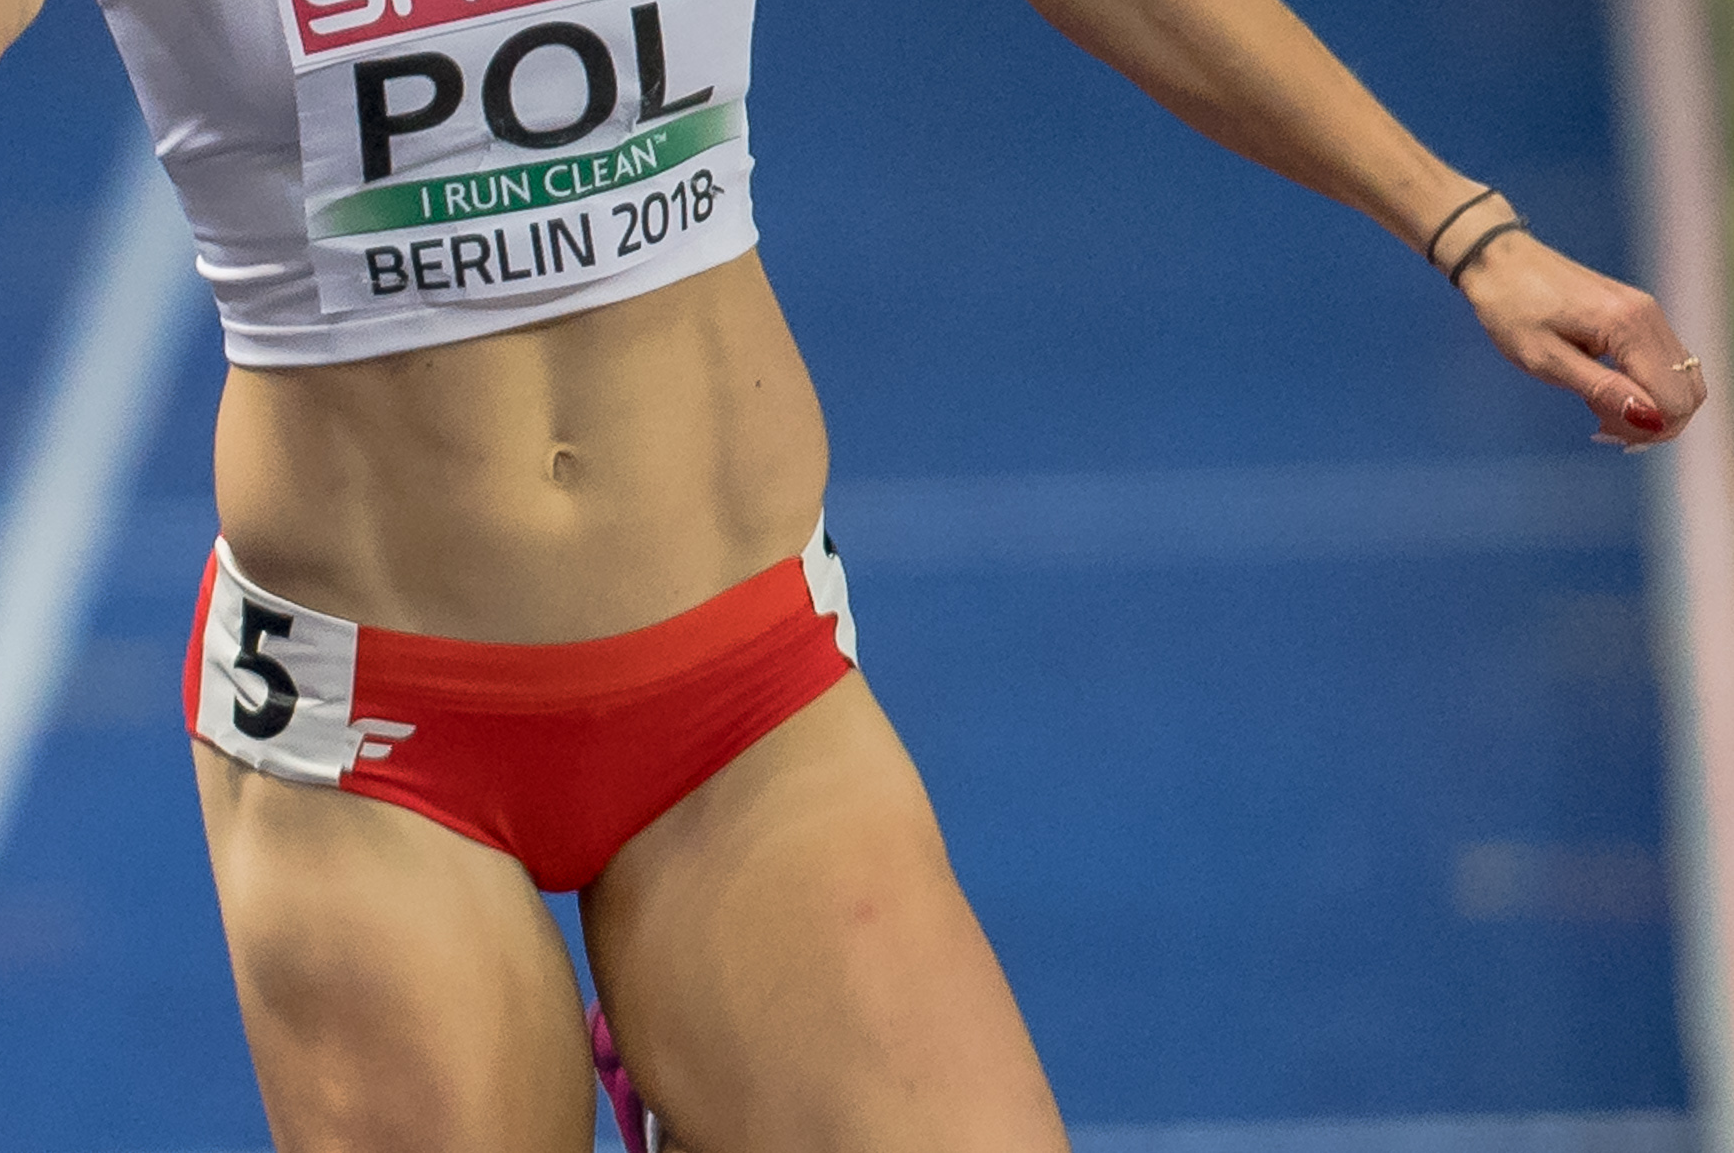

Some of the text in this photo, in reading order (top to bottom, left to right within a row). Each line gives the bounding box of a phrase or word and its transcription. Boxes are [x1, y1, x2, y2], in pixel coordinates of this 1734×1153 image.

[354, 2, 715, 182] POL
[367, 169, 716, 296] BERLIN 2018
[420, 187, 431, 218] I
[444, 171, 531, 216] RUN
[232, 597, 298, 740] 5
